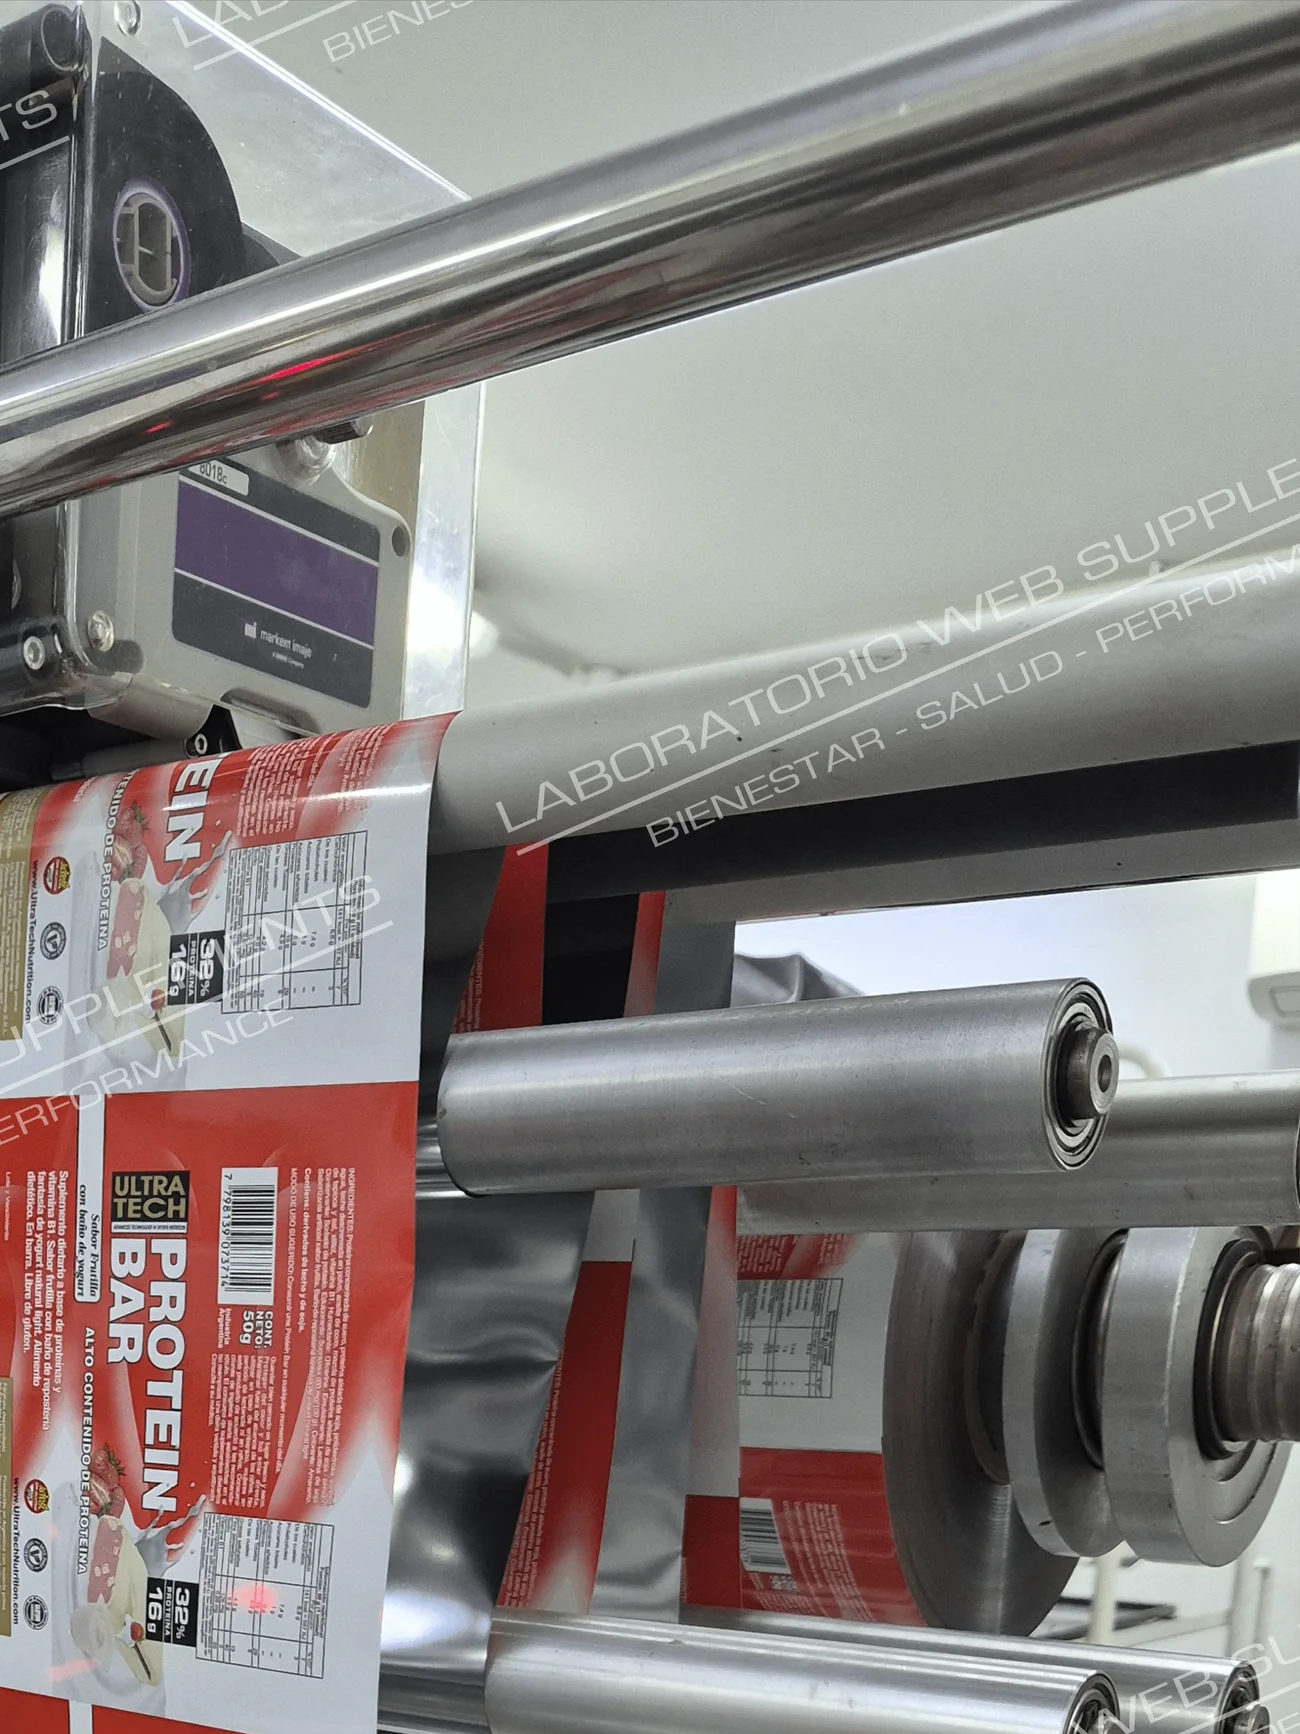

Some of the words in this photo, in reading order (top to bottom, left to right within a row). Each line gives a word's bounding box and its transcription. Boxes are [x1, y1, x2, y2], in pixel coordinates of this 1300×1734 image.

[260, 628, 292, 650] markem
[164, 758, 217, 863] EIN
[56, 1170, 68, 1236] Suplemento
[78, 1183, 87, 1206] con
[112, 1173, 187, 1197] ULTRA
[77, 1208, 88, 1238] baño
[112, 1196, 187, 1219] TECH
[221, 1189, 233, 1236] 798139
[76, 1241, 87, 1255] de
[89, 1213, 100, 1250] Sabor
[45, 1239, 55, 1272] Sabor
[72, 1256, 86, 1297] yogurt
[87, 1251, 99, 1297] Frutilla
[219, 1241, 230, 1287] 073714
[106, 1237, 147, 1366] BAR
[82, 1325, 95, 1367] ALTO
[238, 1309, 255, 1345] 50g
[253, 1310, 265, 1349] NETO:
[262, 1310, 274, 1348] CONT.
[140, 1237, 188, 1514] PROTEIN
[79, 1371, 94, 1467] CONTENIDO
[79, 1469, 91, 1493] DE
[12, 1476, 20, 1625] www.UltraTechNutrition.com
[76, 1495, 91, 1576] PROTEINA
[144, 1583, 164, 1635] 16g
[163, 1585, 173, 1637] PROTEINA
[173, 1586, 190, 1640] 32%
